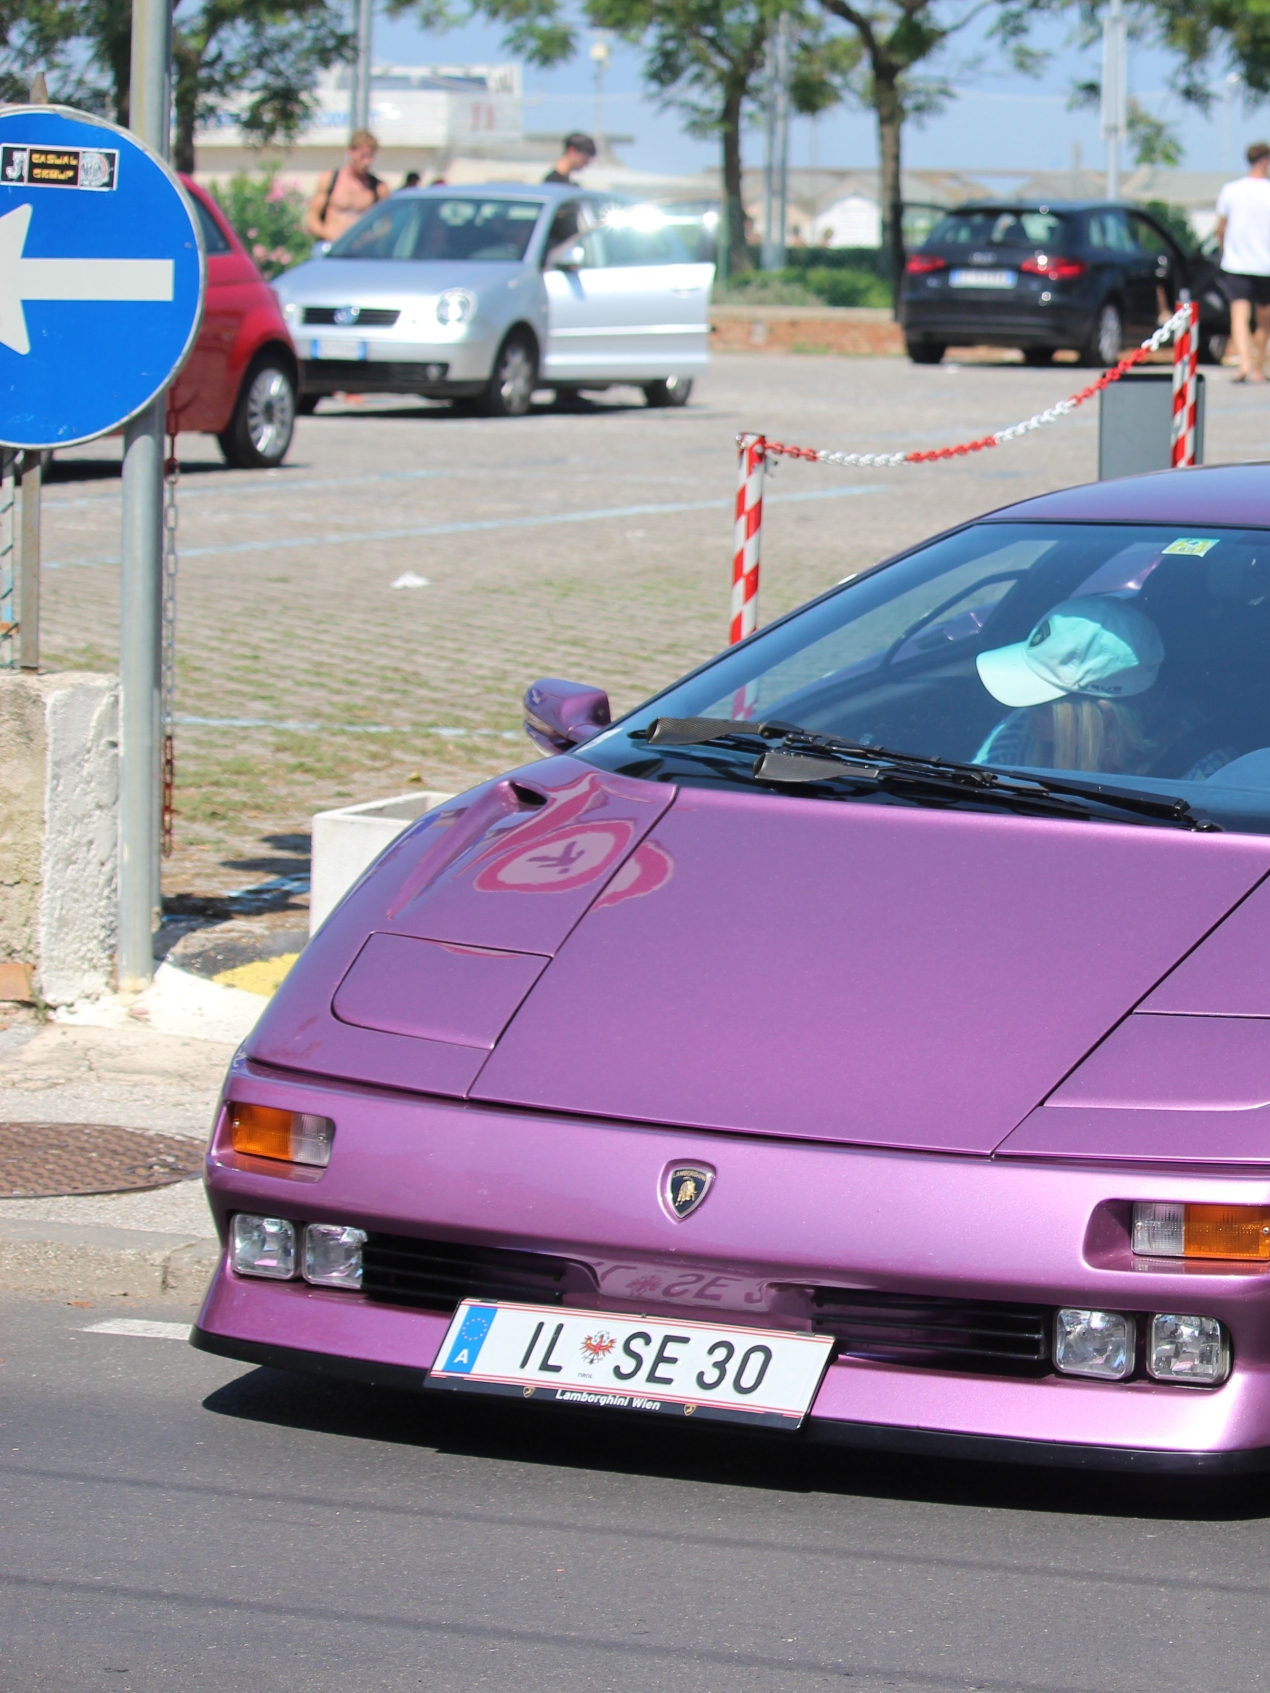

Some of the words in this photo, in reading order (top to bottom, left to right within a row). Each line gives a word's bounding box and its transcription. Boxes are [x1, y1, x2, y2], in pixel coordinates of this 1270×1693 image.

[31, 153, 78, 165] CASUAL
[453, 1348, 470, 1365] A
[519, 1321, 564, 1374] IL
[612, 1331, 691, 1386] SE
[695, 1340, 773, 1395] 30
[577, 1372, 594, 1380] TIROL
[555, 1389, 630, 1406] Lamborghini
[631, 1397, 661, 1411] Wien
